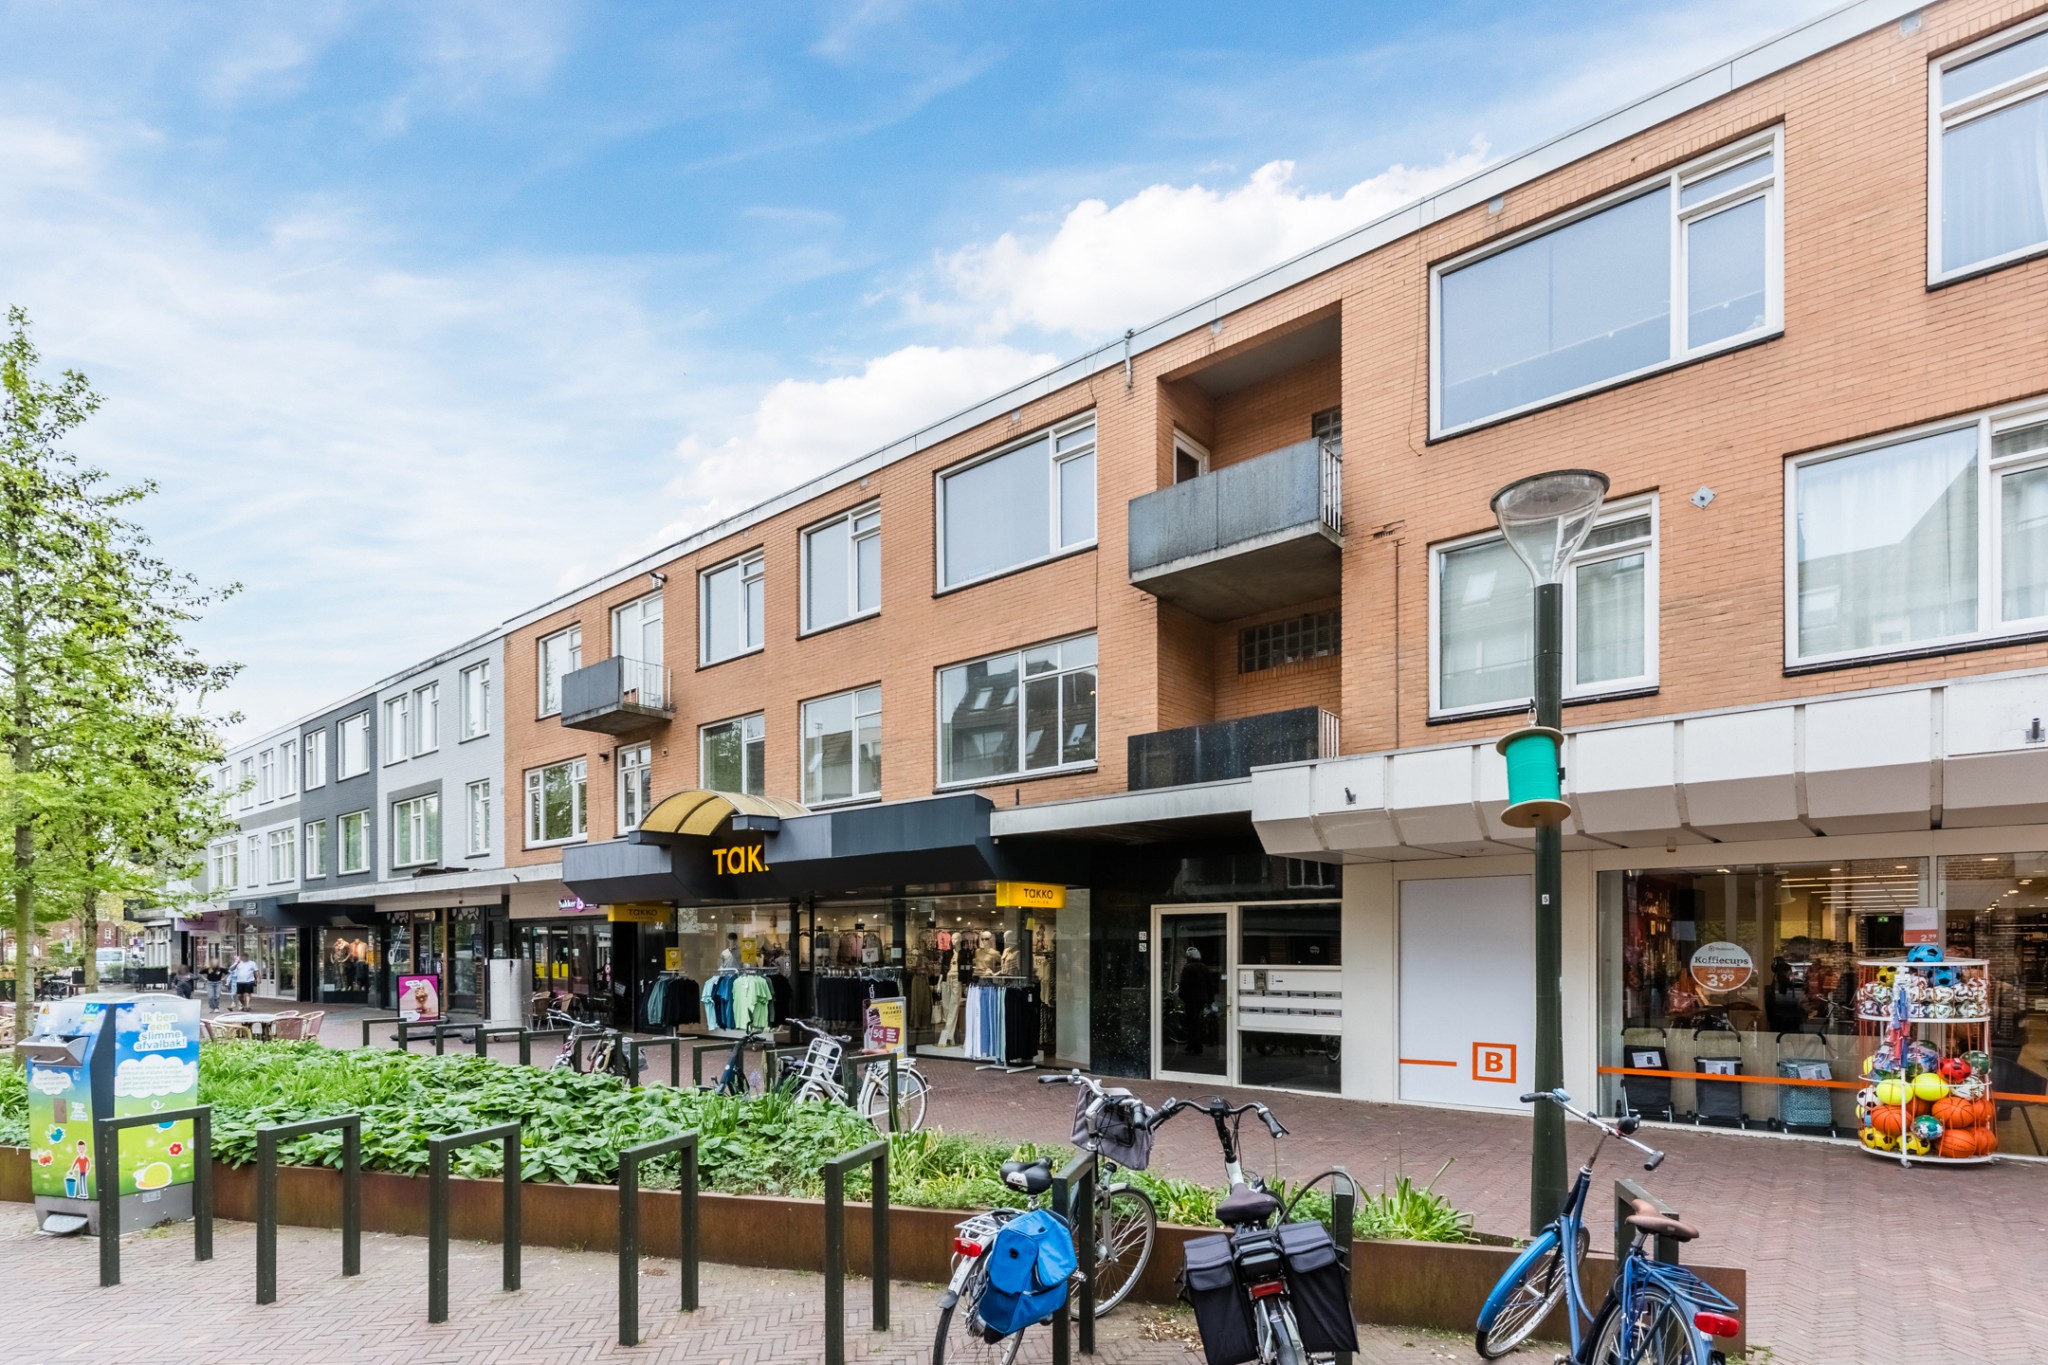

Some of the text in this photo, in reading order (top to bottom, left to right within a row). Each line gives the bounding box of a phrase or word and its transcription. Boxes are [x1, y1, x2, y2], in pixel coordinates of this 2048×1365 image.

[1023, 888, 1054, 900] TAKKO
[627, 908, 658, 917] TAKKO
[1694, 955, 1749, 966] Koffiecups
[1707, 973, 1735, 987] 3.99
[143, 1012, 177, 1023] Ik ben
[150, 1022, 170, 1031] een
[141, 1031, 182, 1041] slimme
[135, 1038, 185, 1050] afvalbak!
[1485, 1051, 1504, 1073] B
